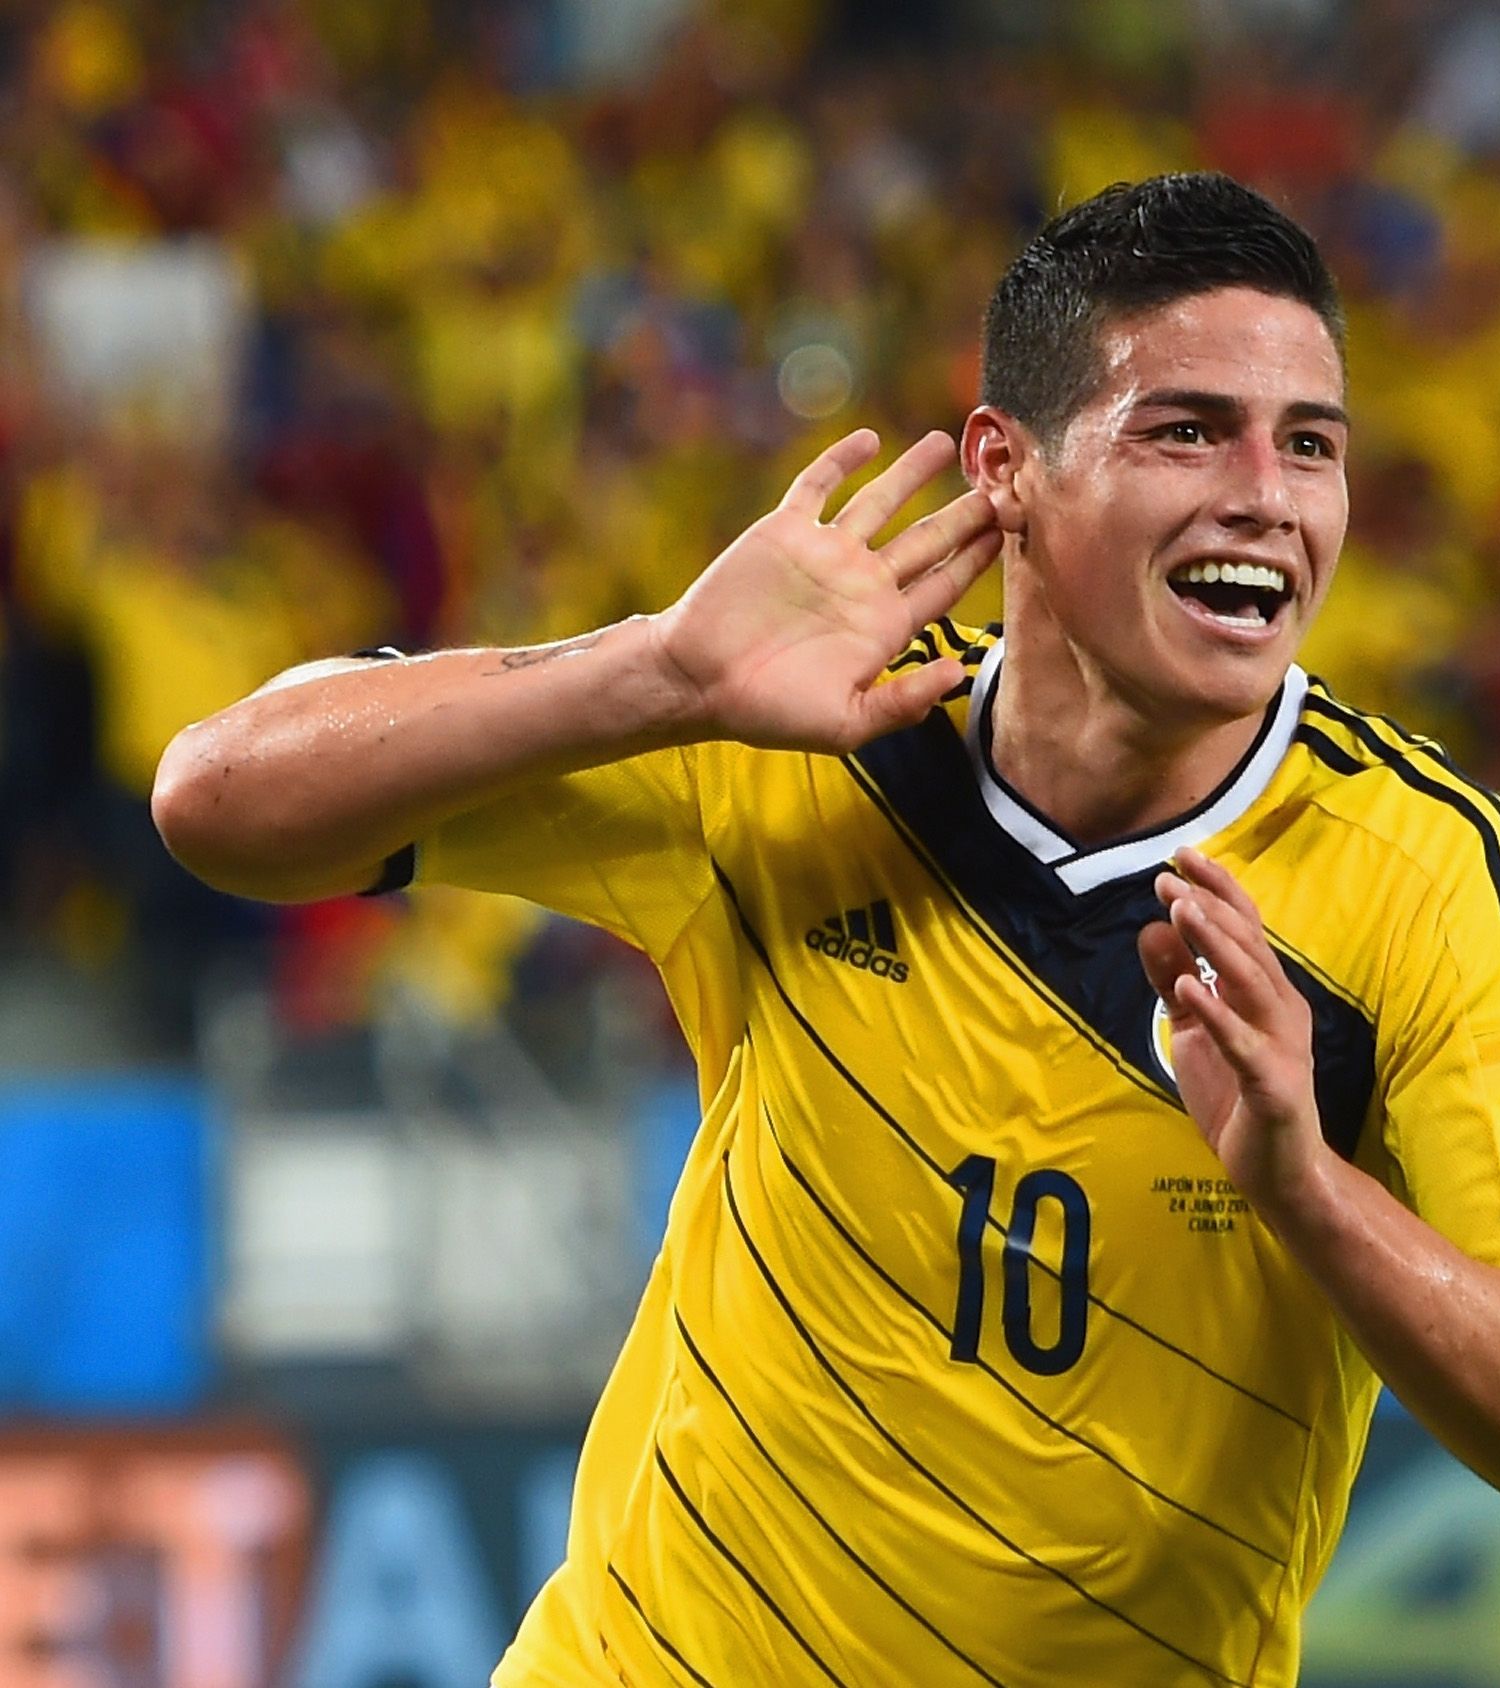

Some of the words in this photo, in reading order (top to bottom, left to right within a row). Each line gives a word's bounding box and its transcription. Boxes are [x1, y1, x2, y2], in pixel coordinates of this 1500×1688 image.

[804, 928, 909, 983] adidas
[1196, 1178, 1213, 1194] VS
[1169, 1197, 1186, 1213] 24
[949, 1153, 1091, 1376] 10
